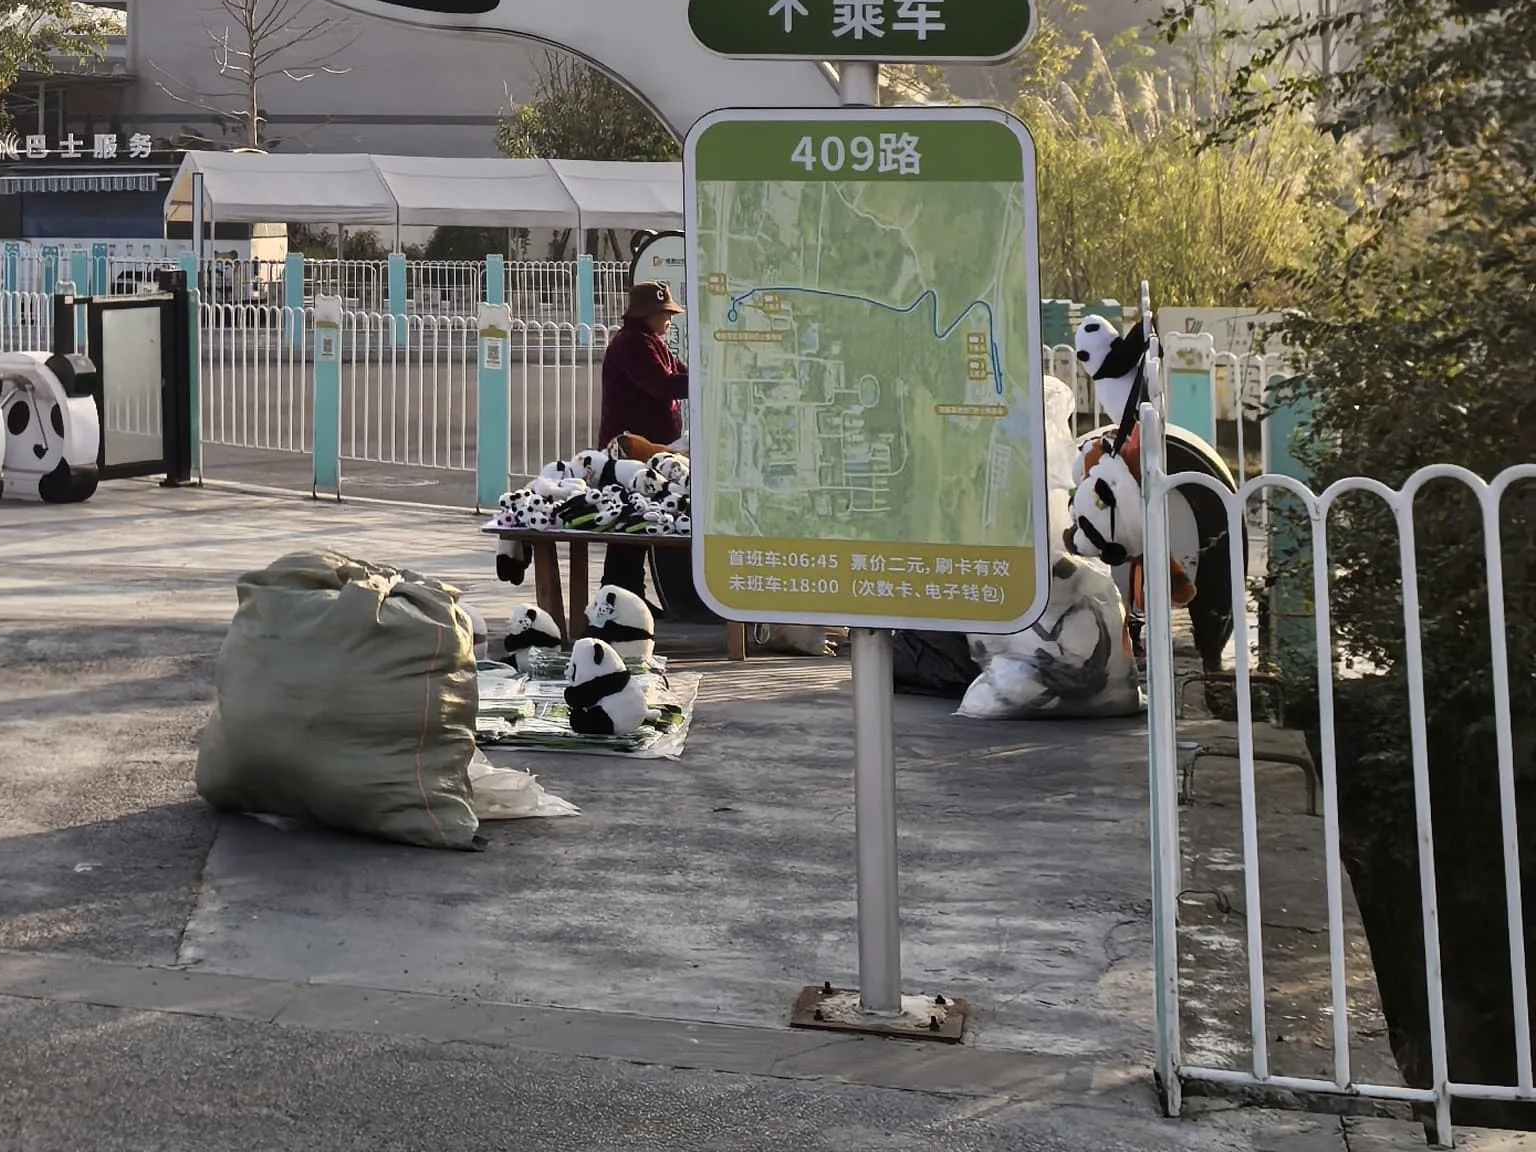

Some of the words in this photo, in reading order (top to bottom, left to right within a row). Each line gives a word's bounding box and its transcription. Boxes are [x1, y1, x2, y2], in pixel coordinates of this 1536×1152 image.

[25, 132, 153, 160] 巴士服务
[791, 132, 921, 176] 409路
